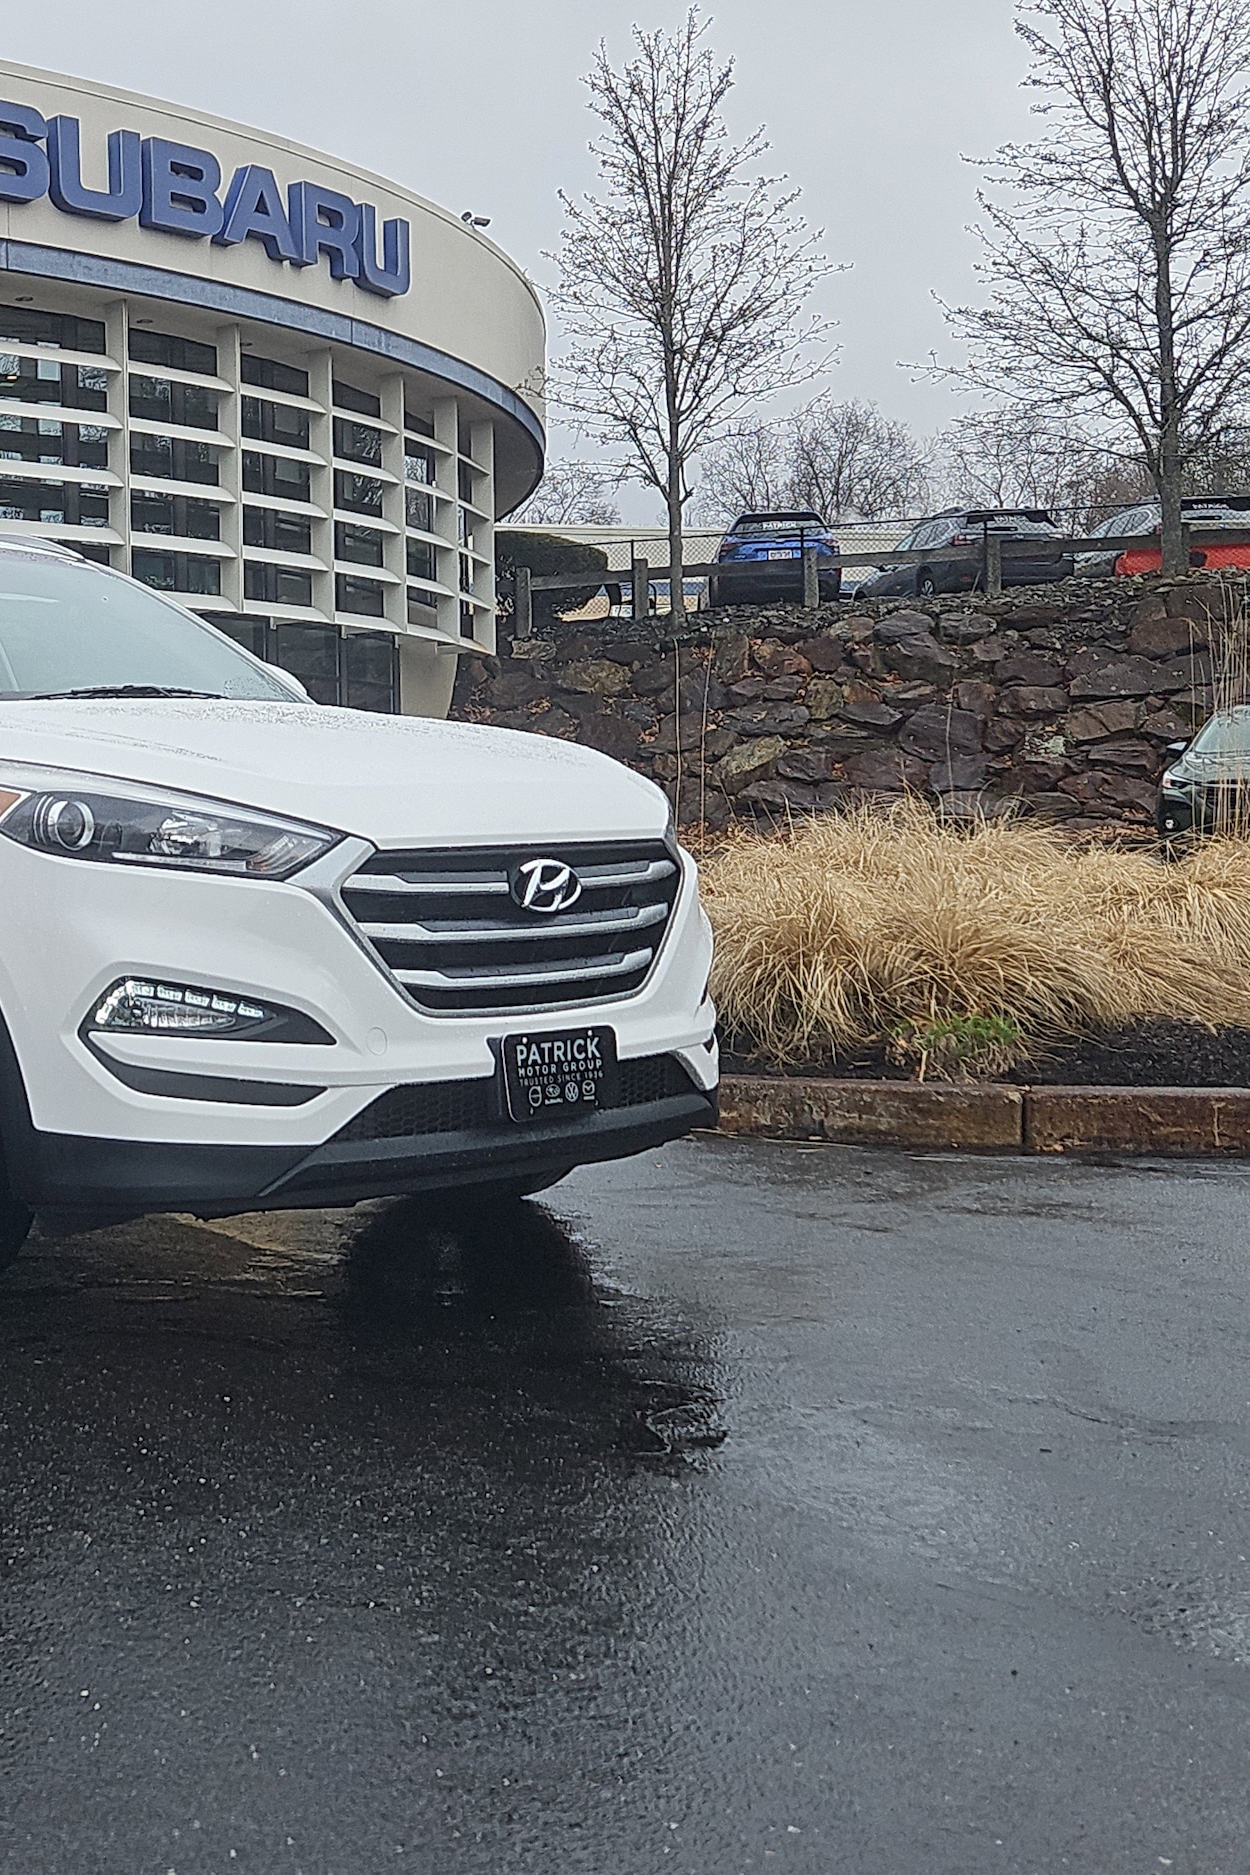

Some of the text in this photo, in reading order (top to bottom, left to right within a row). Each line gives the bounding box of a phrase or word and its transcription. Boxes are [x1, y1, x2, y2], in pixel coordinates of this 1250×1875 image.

[762, 520, 797, 530] PATRICK
[516, 1037, 601, 1067] PATRICK
[518, 1059, 602, 1078] MOTOR GROUP
[519, 1076, 554, 1087] TRUSTED
[557, 1072, 581, 1083] SINCE
